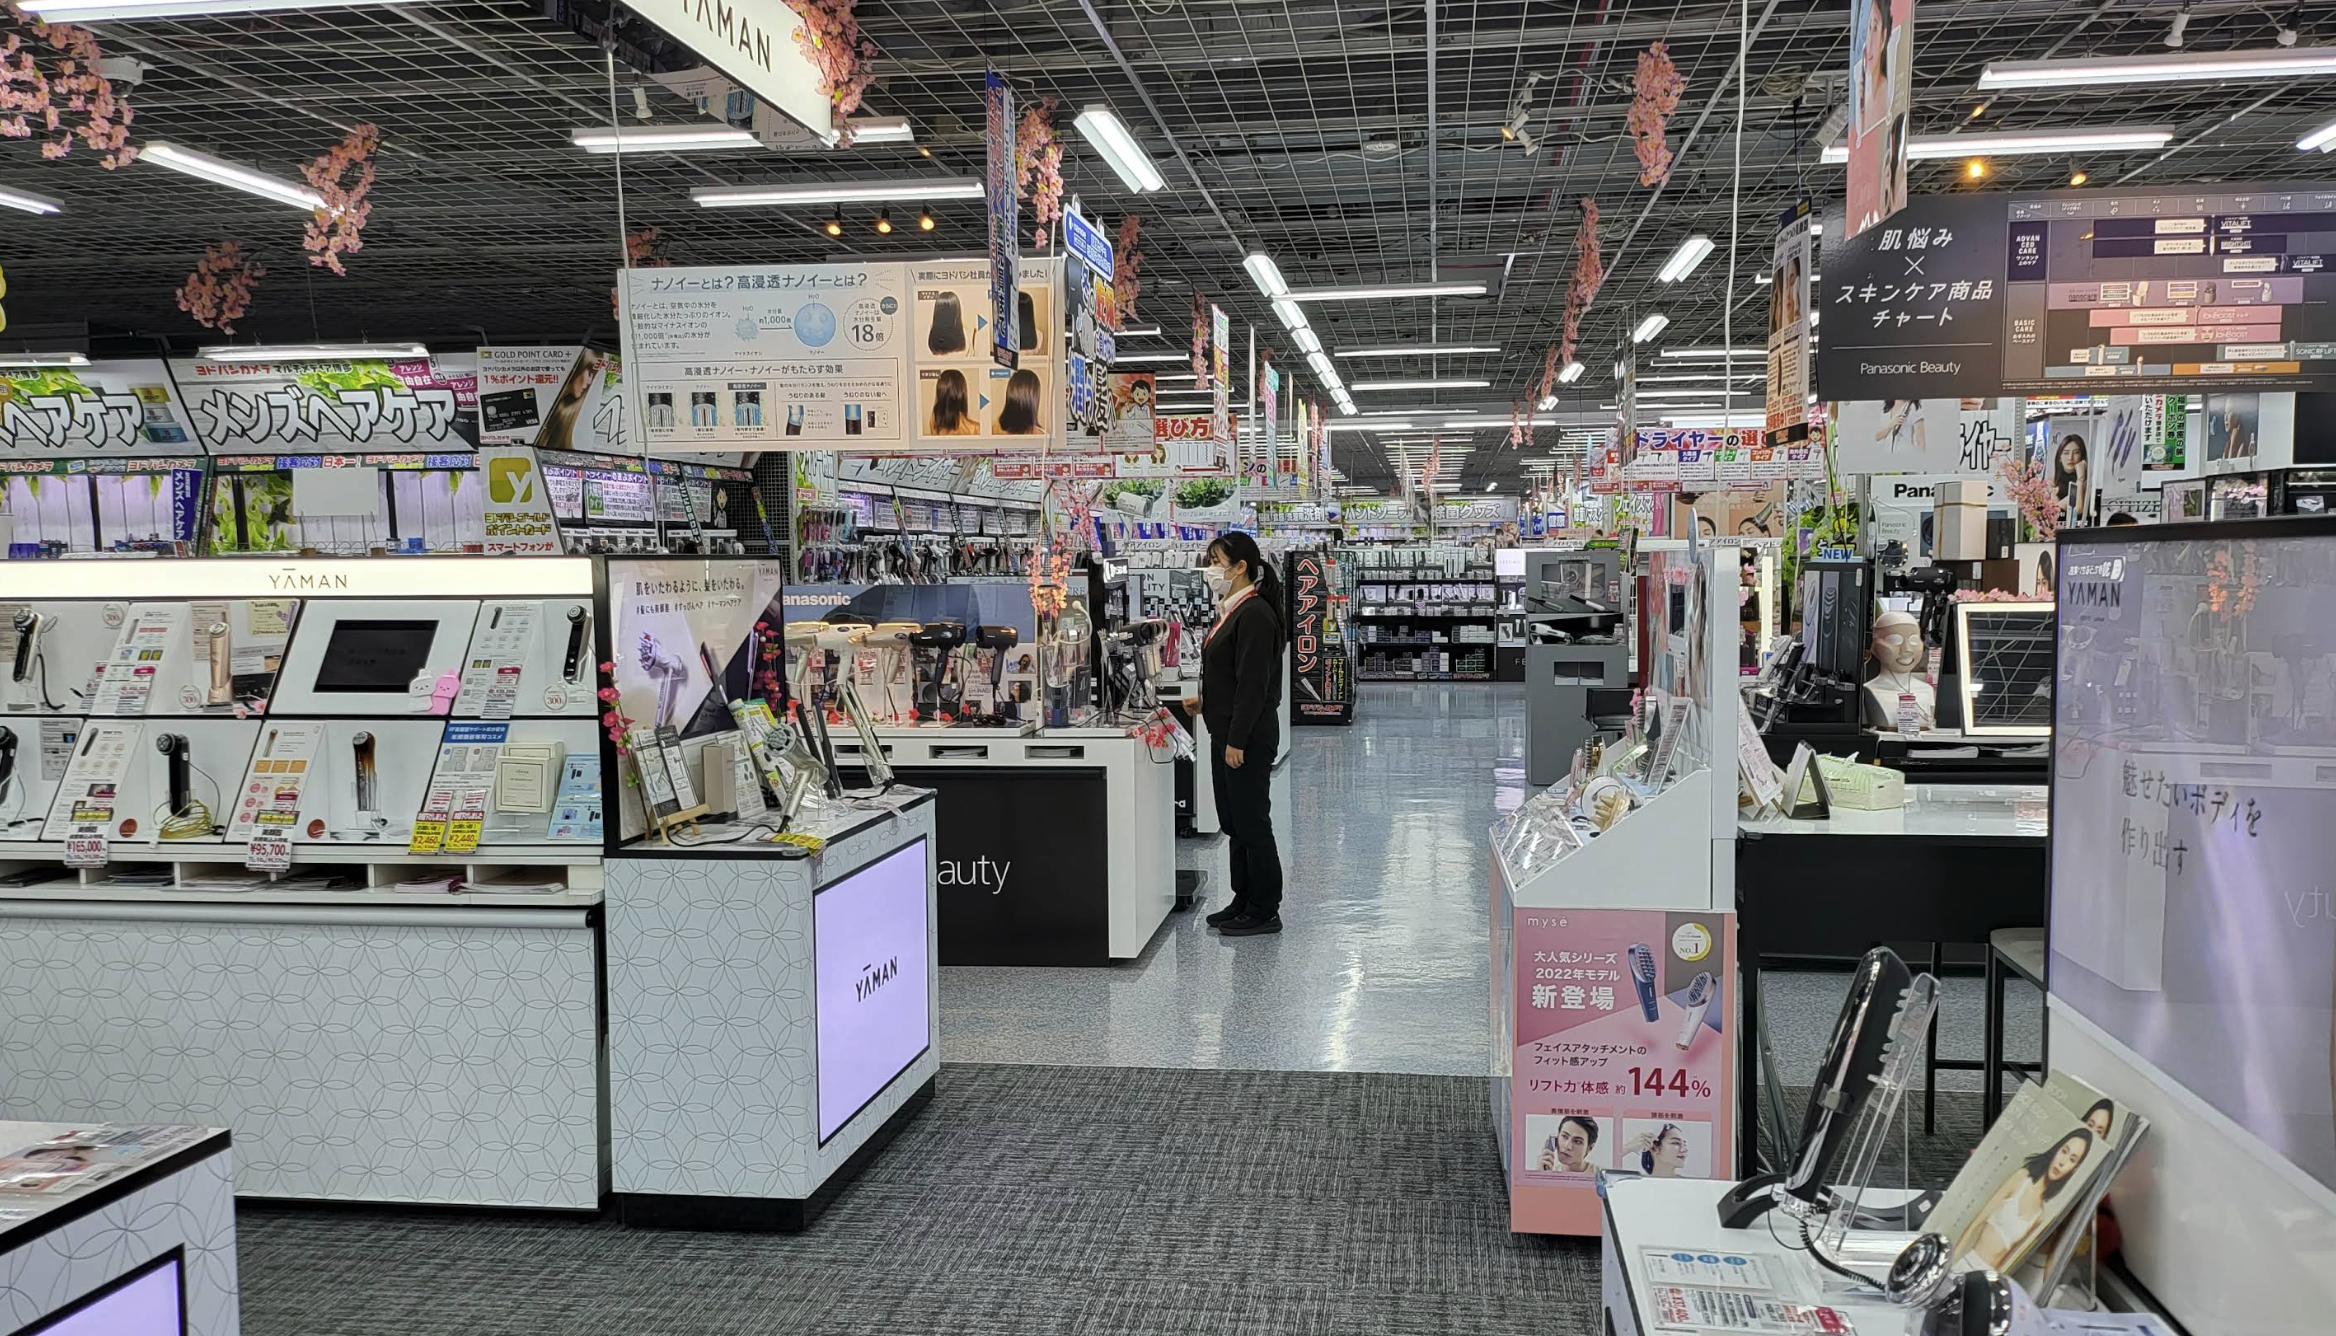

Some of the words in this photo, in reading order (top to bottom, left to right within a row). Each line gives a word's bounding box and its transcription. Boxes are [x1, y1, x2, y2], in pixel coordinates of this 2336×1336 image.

[683, 0, 771, 73] AMAN
[1878, 227, 1953, 251] 肌悩み
[2018, 247, 2037, 255] CARE
[1835, 279, 1994, 304] スキンケア商品
[1872, 306, 1953, 329] チャート
[2014, 319, 2036, 327] BASIC
[2015, 325, 2034, 333] CARE
[494, 350, 516, 359] GOLD
[517, 350, 541, 359] POINT
[542, 350, 564, 359] CARD
[195, 364, 271, 376] ヨドバシカメラ
[684, 364, 843, 376] 高浸透ナノイー・ナノイーがもたらす効果
[1860, 361, 1917, 375] Panasonic
[1920, 360, 1961, 376] Beauty
[0, 392, 144, 448] ヘアケア
[201, 383, 456, 446] メンズヘアケア
[1960, 420, 2012, 471] イヤー
[127, 458, 197, 471] ヨドバシカメラ
[217, 456, 275, 465] ヨドバシカメラ
[174, 471, 186, 540] メンズヘアケア
[1433, 504, 1500, 520] 除菌グッズ
[484, 512, 551, 524] ヨドバシゴールド
[485, 523, 551, 536] ポイントカード
[487, 541, 554, 553] スマートフォンが
[1823, 549, 1853, 560] NEW
[1297, 558, 1320, 673] ヘアアイロン
[2122, 759, 2262, 838] 魅せたいボディを
[67, 840, 102, 853] ¥165,000
[250, 843, 286, 857] ¥95,700
[2120, 816, 2189, 876] 作り出す
[937, 855, 1010, 894] auty
[1527, 915, 1568, 928] mysé
[1534, 950, 1617, 964] 大人気シリーズ
[1536, 968, 1620, 982] 2022年モデル
[1531, 984, 1615, 1011] 新登場
[1534, 1042, 1647, 1056] フェイスアタッチメントの
[1533, 1056, 1608, 1067] フィット感アップ
[1615, 1084, 1626, 1095] 約
[1628, 1066, 1711, 1098] 144%
